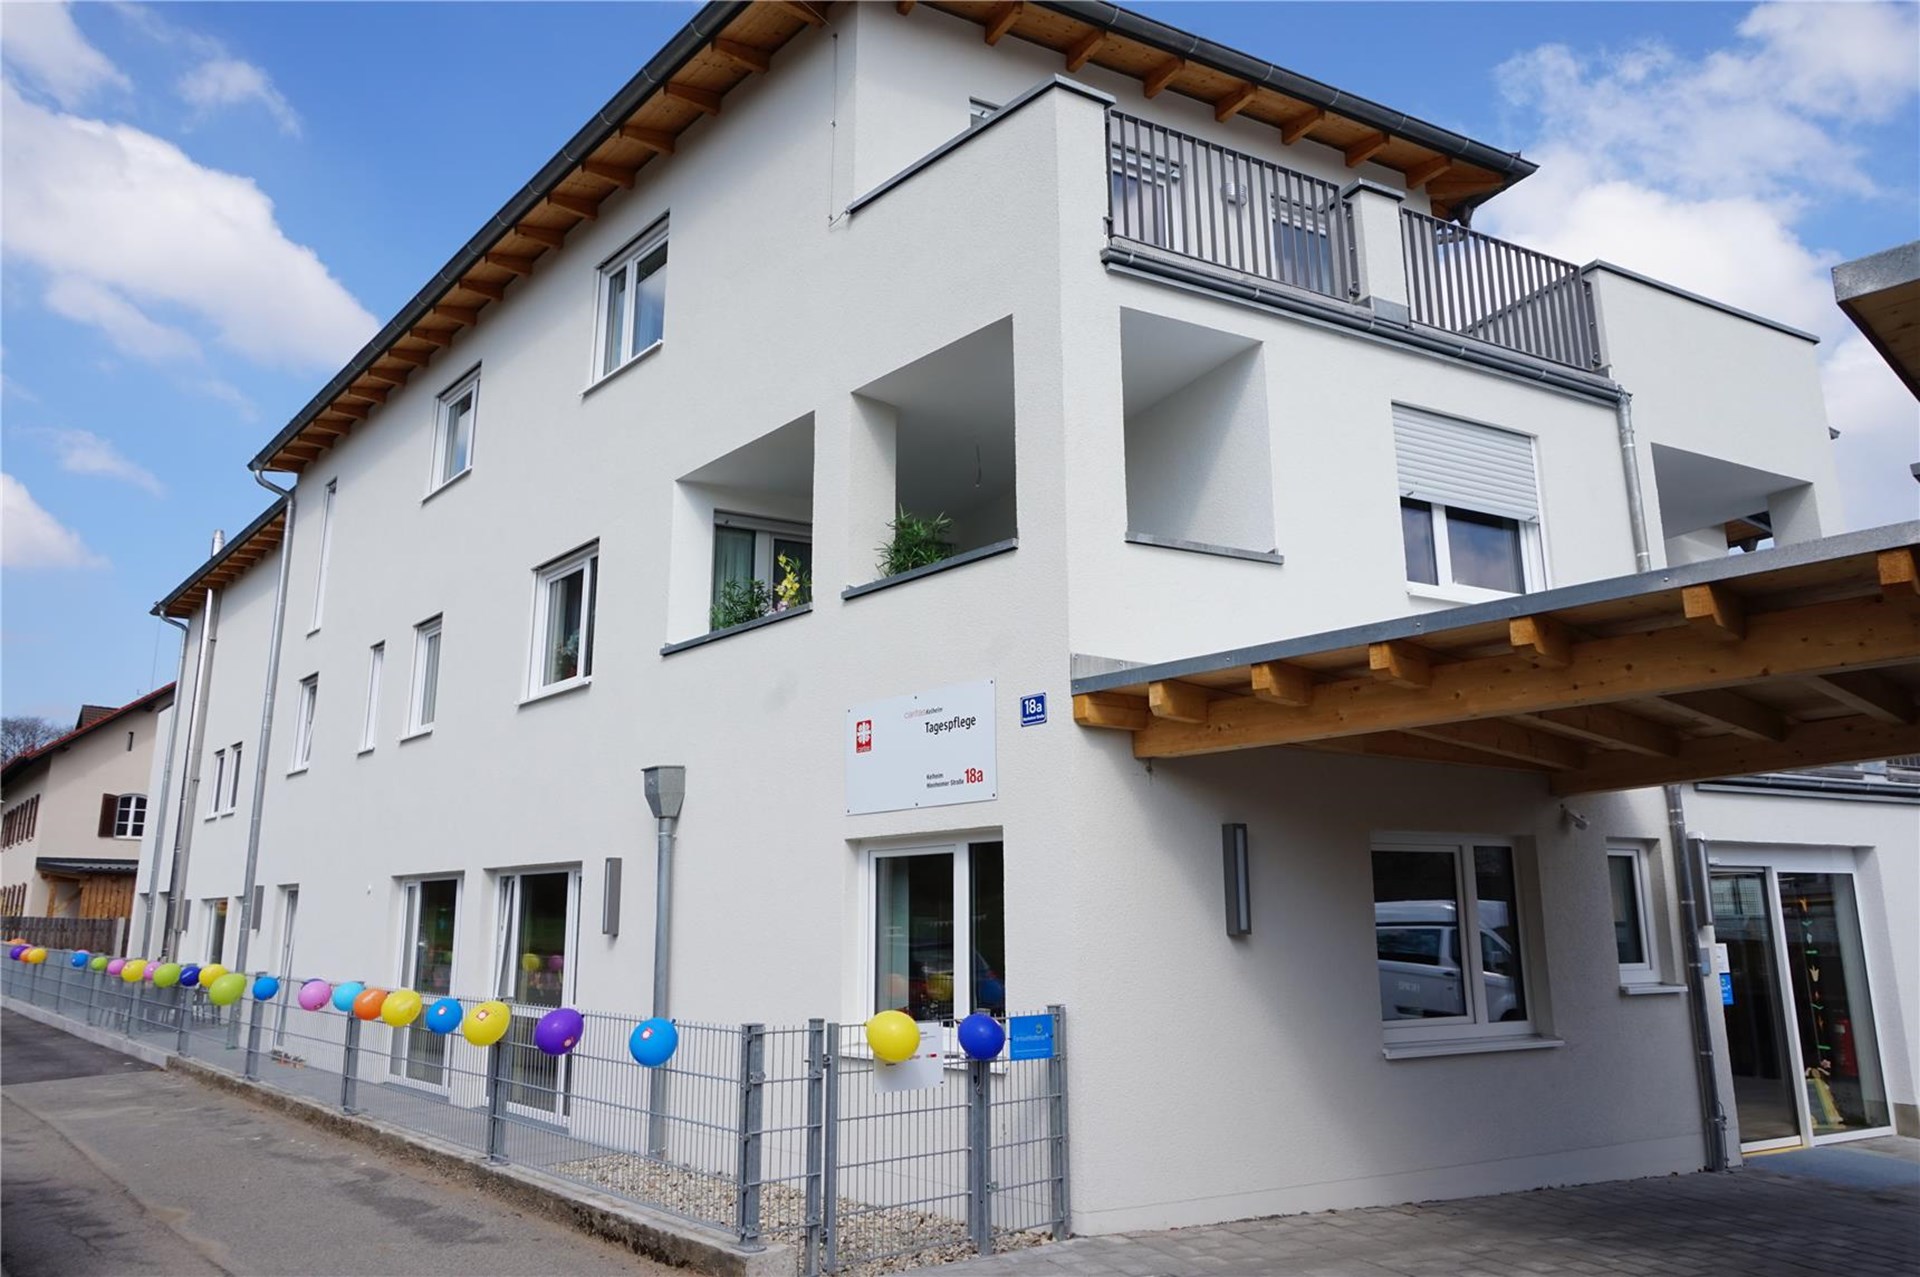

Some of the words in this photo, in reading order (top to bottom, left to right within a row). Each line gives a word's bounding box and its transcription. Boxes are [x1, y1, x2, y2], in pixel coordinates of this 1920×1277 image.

[1024, 699, 1043, 715] 18a
[925, 716, 976, 735] Tagespflege
[964, 768, 983, 784] 18a
